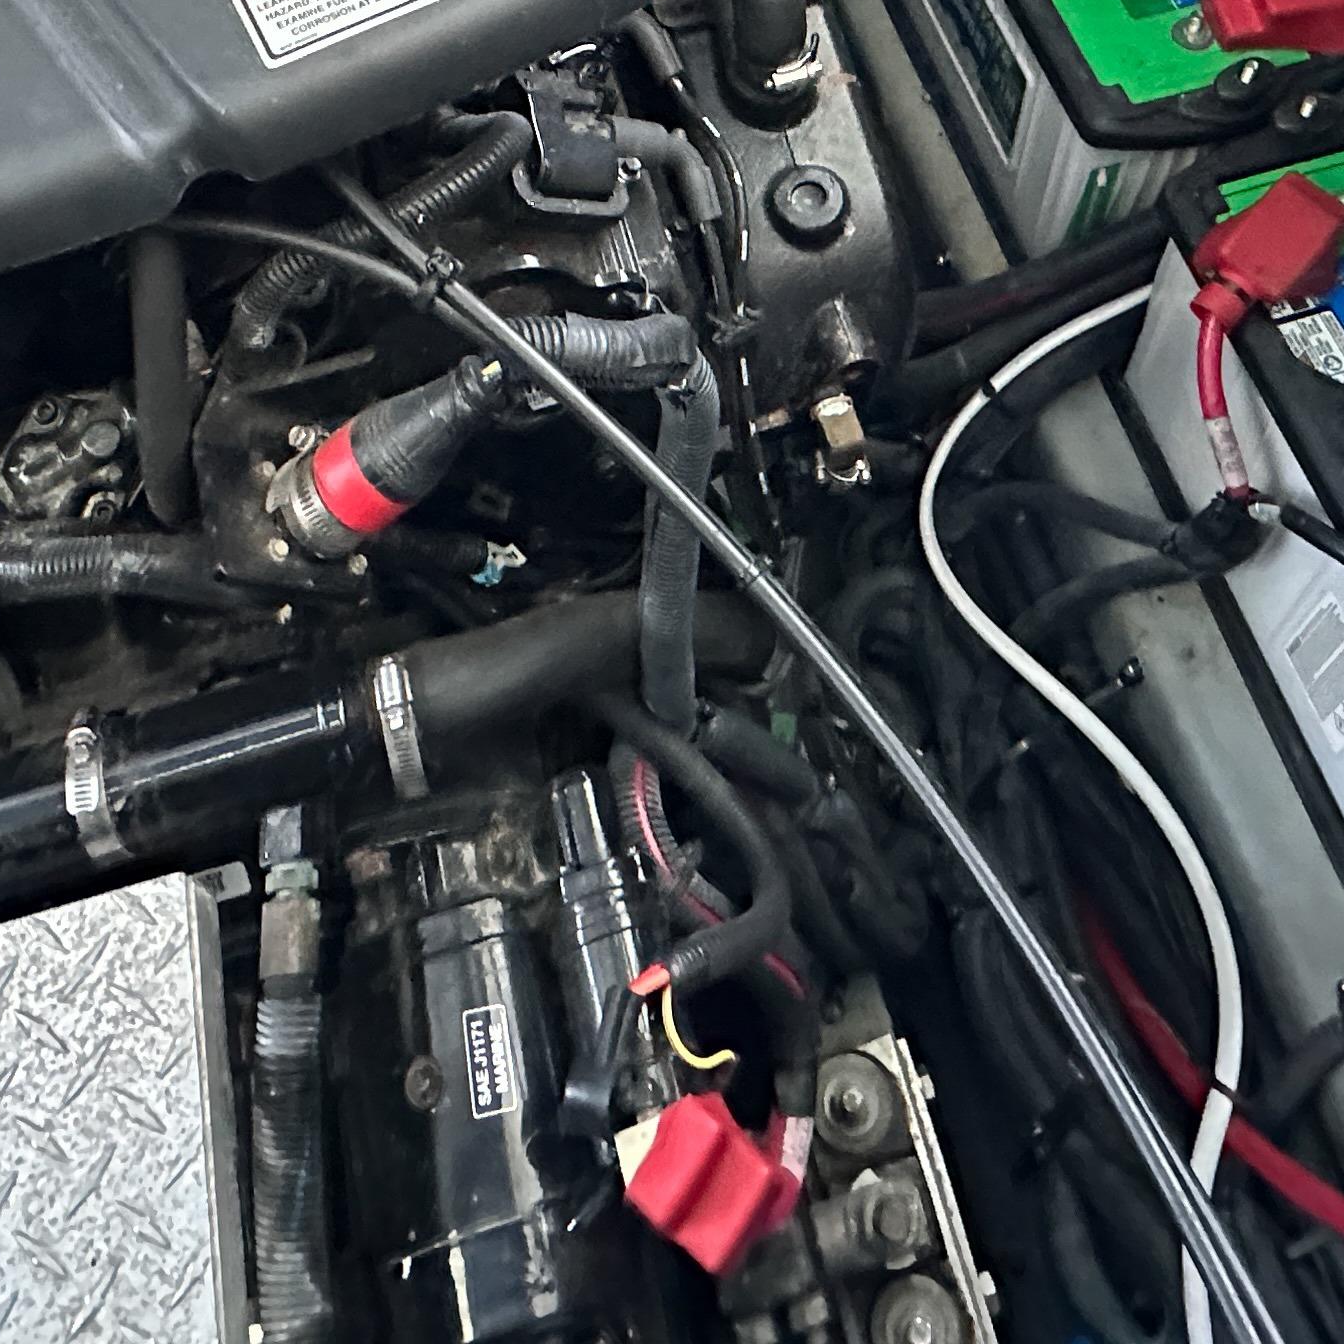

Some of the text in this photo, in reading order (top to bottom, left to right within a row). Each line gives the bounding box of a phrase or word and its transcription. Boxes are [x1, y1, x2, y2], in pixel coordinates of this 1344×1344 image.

[290, 3, 356, 36] CORROSION
[470, 1020, 491, 1104] SAE J1171
[489, 1023, 507, 1092] MARINE
